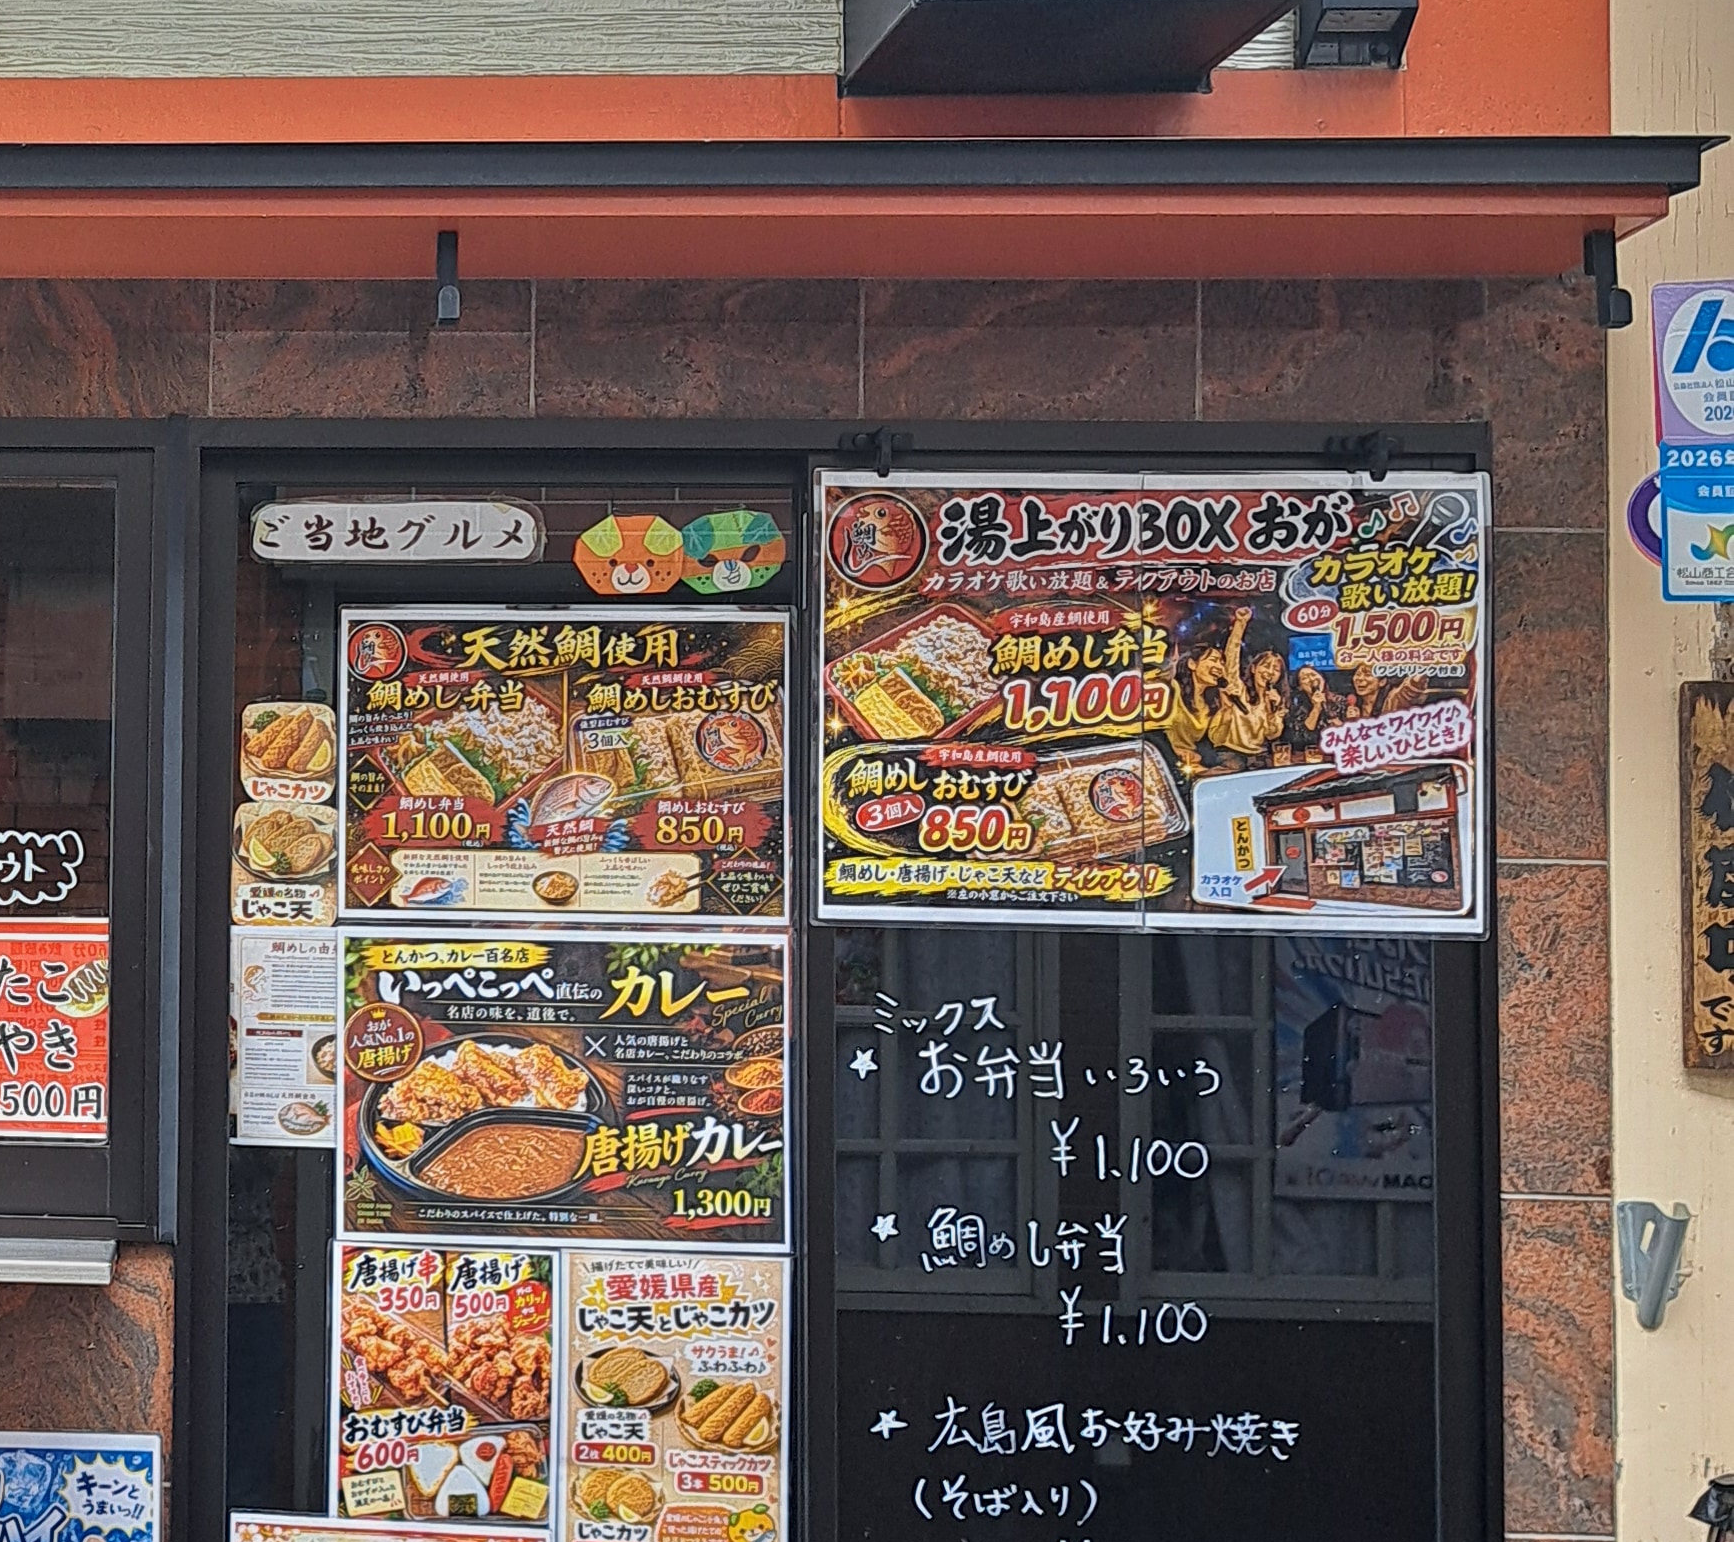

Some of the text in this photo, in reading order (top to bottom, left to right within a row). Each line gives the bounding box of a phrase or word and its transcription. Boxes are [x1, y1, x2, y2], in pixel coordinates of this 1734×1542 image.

[258, 512, 526, 553] ご当地グルメ
[1247, 494, 1348, 551] おが
[1311, 547, 1436, 584] カラオケ
[1297, 605, 1331, 623] 60分
[1335, 611, 1465, 649] 1,500円
[455, 625, 679, 670] 天然鯛使用
[992, 625, 1167, 674] 鯛めし弁当
[366, 679, 525, 711] 鯛めし弁当
[587, 679, 779, 713] 鯛めしおむすび
[587, 732, 630, 749] 3個入
[251, 780, 327, 800] じゃこカツ
[847, 759, 1033, 801] 鯛めし おむすび
[399, 796, 465, 811] 鯛めし弁当
[657, 800, 745, 815] 鯛めしおむすび
[865, 796, 921, 826] 3個入
[381, 812, 491, 842] 1,100円
[546, 820, 594, 836] 天然鯛
[655, 816, 744, 845] 850円
[920, 806, 1030, 852] 850円
[1236, 820, 1251, 868] とんかつ
[1200, 874, 1243, 886] カラオケ
[1210, 886, 1232, 897] 入口
[242, 899, 314, 920] じゃこ天
[382, 947, 530, 965] とんかつ、カレー百名店
[599, 965, 750, 1020] カレー
[711, 985, 768, 1027] Special
[745, 1005, 783, 1027] Curry
[872, 991, 1004, 1036] ミックス
[357, 1043, 412, 1069] 唐揚げ
[0, 1083, 103, 1120] 500円
[573, 1116, 783, 1181] 唐揚げカレー
[675, 1168, 707, 1184] Curry
[673, 1189, 771, 1222] 1,300円
[350, 1251, 438, 1289] 唐揚げ串
[451, 1257, 525, 1291] 唐揚げ
[378, 1287, 439, 1312] 350円
[606, 1274, 719, 1301] 愛媛県産
[454, 1291, 508, 1318] 500円
[579, 1301, 775, 1332] じゃこ天とじゃこカツ
[346, 1407, 465, 1441] おむすび弁当
[581, 1422, 644, 1441] じゃこ天
[356, 1441, 419, 1472] 600円
[602, 1446, 652, 1463] 400円
[669, 1452, 773, 1472] じゃこスティックカツ
[76, 1471, 141, 1499] キーンと
[709, 1475, 759, 1493] 500円
[578, 1523, 648, 1540] じゃこカツ
